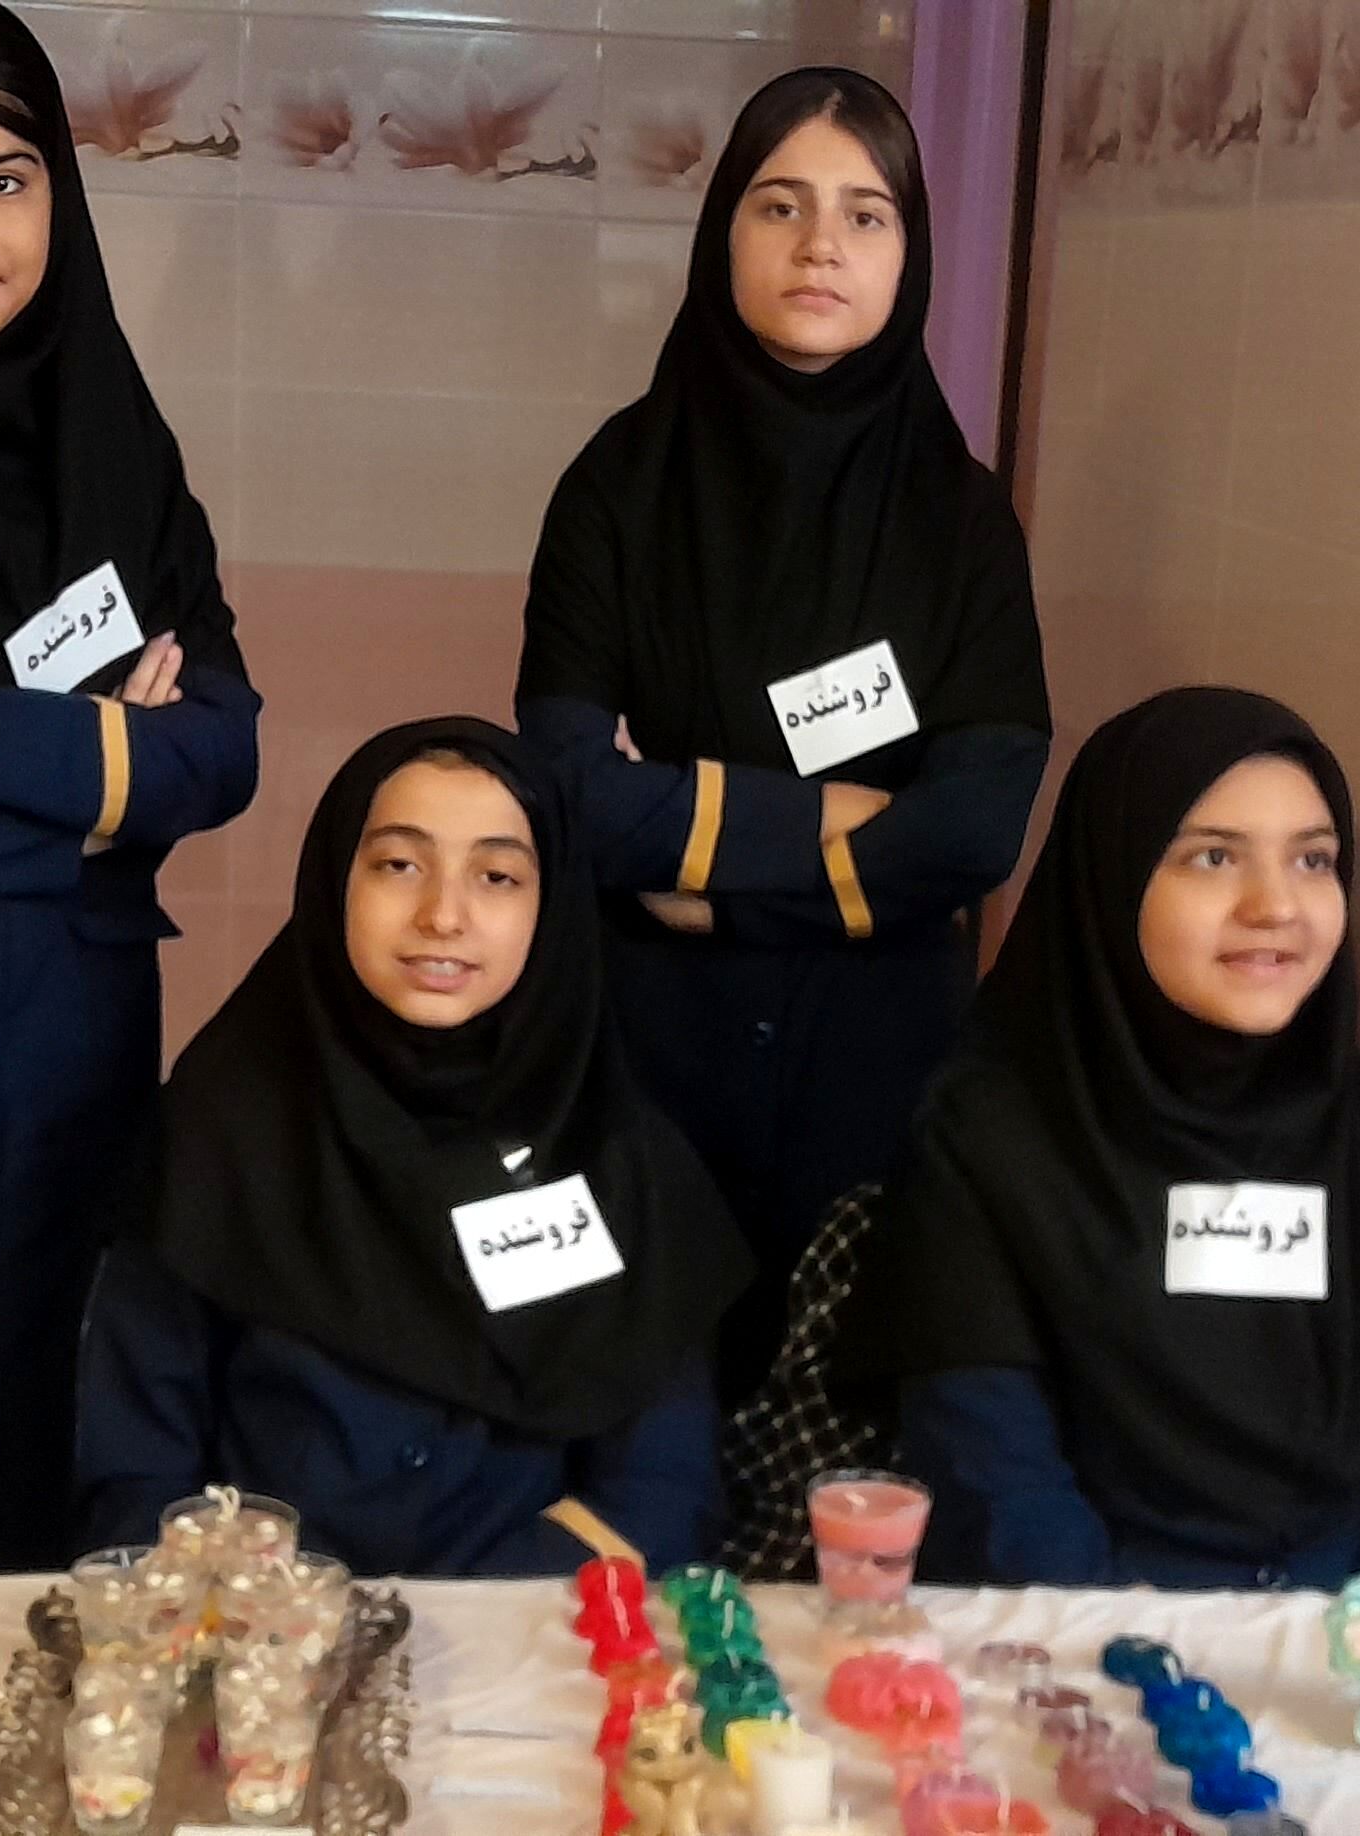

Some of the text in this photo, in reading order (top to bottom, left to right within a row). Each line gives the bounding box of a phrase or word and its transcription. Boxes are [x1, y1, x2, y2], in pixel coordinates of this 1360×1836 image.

[26, 584, 118, 671] فروشنده
[785, 662, 892, 728] فروشنده
[479, 1199, 590, 1257] فروشنده
[1172, 1205, 1310, 1254] فروشنده
